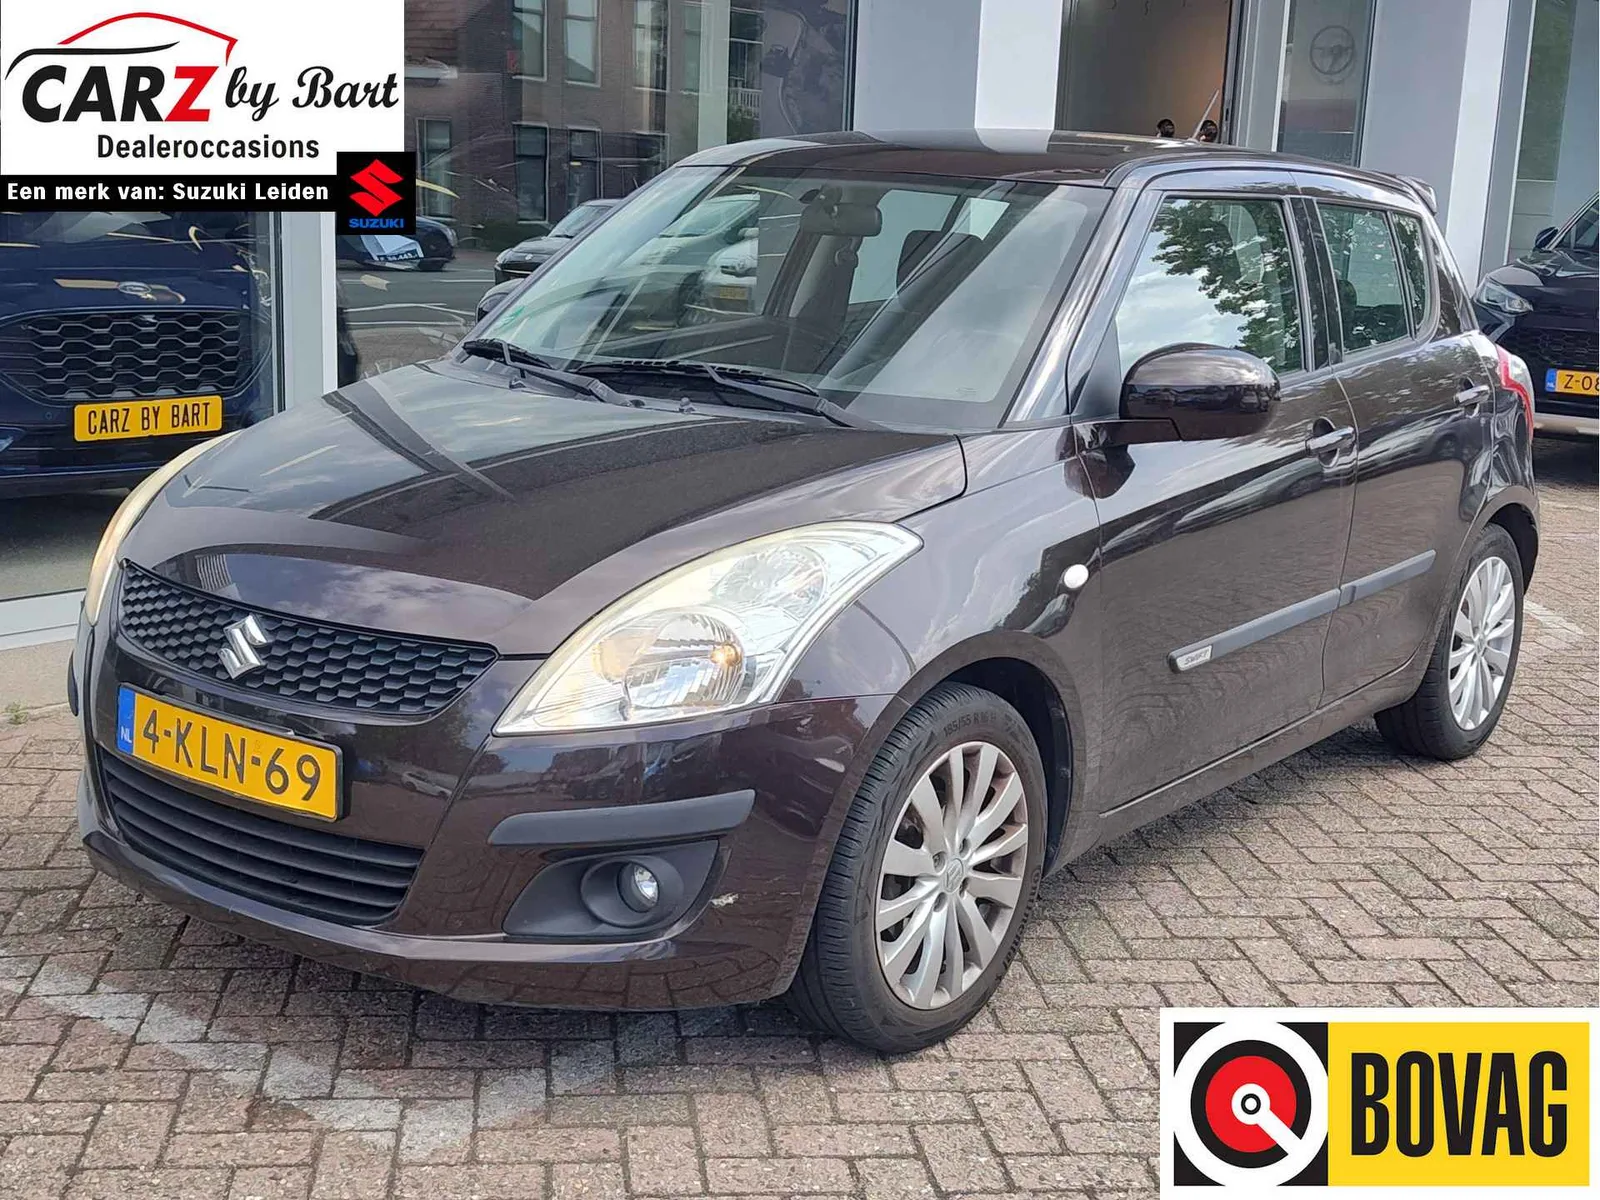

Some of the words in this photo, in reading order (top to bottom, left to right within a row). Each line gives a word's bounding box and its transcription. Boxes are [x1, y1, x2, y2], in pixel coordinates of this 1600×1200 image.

[88, 408, 130, 435] CARZ
[141, 406, 160, 430] BY
[171, 402, 210, 428] BART
[120, 726, 132, 743] NL
[143, 709, 321, 801] 4-KLN-69
